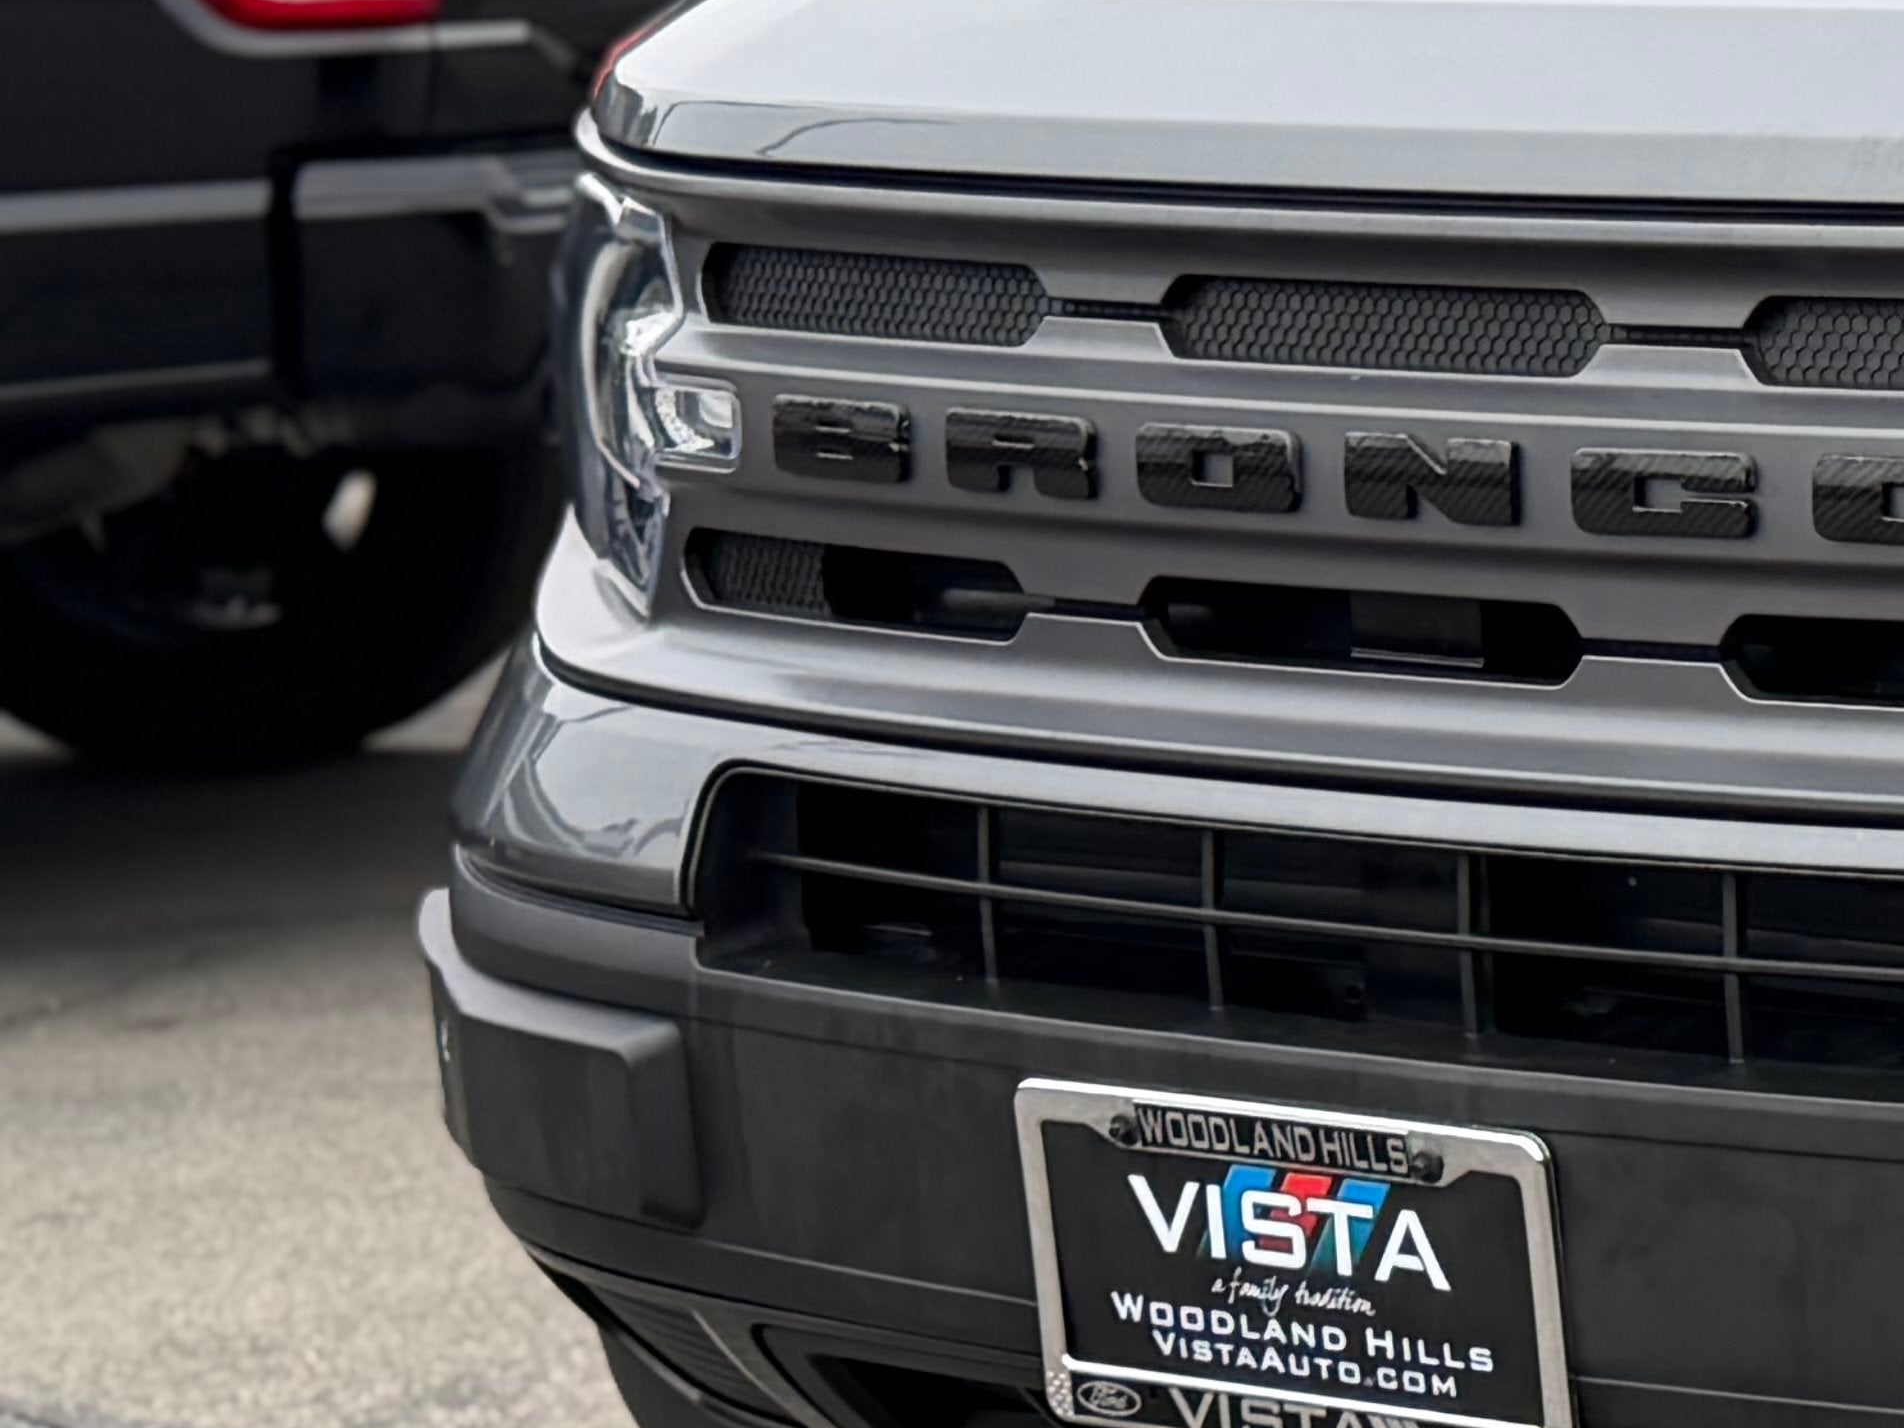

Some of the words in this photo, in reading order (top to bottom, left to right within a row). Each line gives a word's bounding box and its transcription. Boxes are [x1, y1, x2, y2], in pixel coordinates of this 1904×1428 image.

[1137, 1107, 1315, 1164] WOODLAND
[1319, 1130, 1410, 1175] HILLS
[1128, 1173, 1452, 1291] VISTA
[1211, 1277, 1225, 1293] a
[1227, 1266, 1289, 1317] family
[1295, 1280, 1376, 1317] tradition
[1111, 1291, 1348, 1351] WOODLAND
[1366, 1327, 1495, 1373] HILLS
